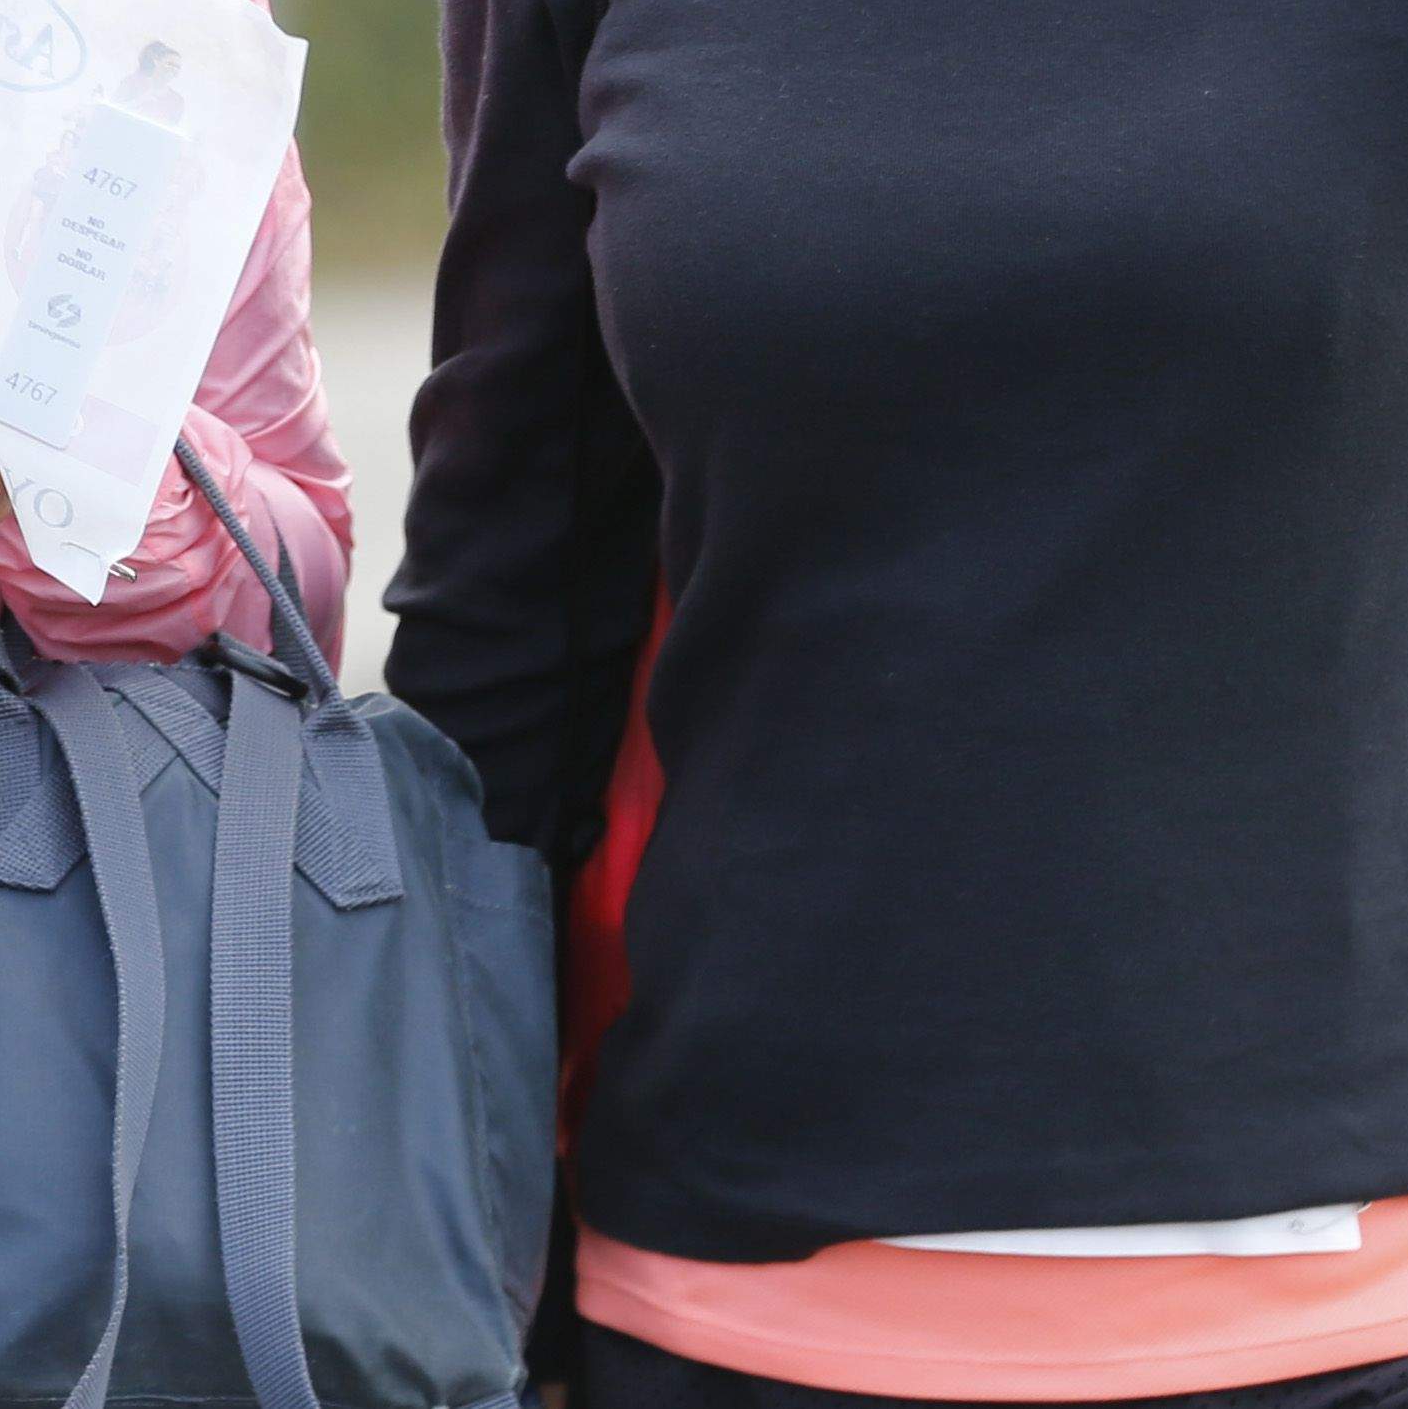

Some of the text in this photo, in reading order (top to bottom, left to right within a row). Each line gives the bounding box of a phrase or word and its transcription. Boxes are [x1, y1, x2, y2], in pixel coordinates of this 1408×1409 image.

[81, 166, 139, 202] 4767
[61, 216, 126, 252] DESPEGAR
[86, 214, 106, 230] NO
[57, 252, 107, 282] DOBLAR
[75, 246, 93, 262] NO
[4, 370, 59, 407] 4767
